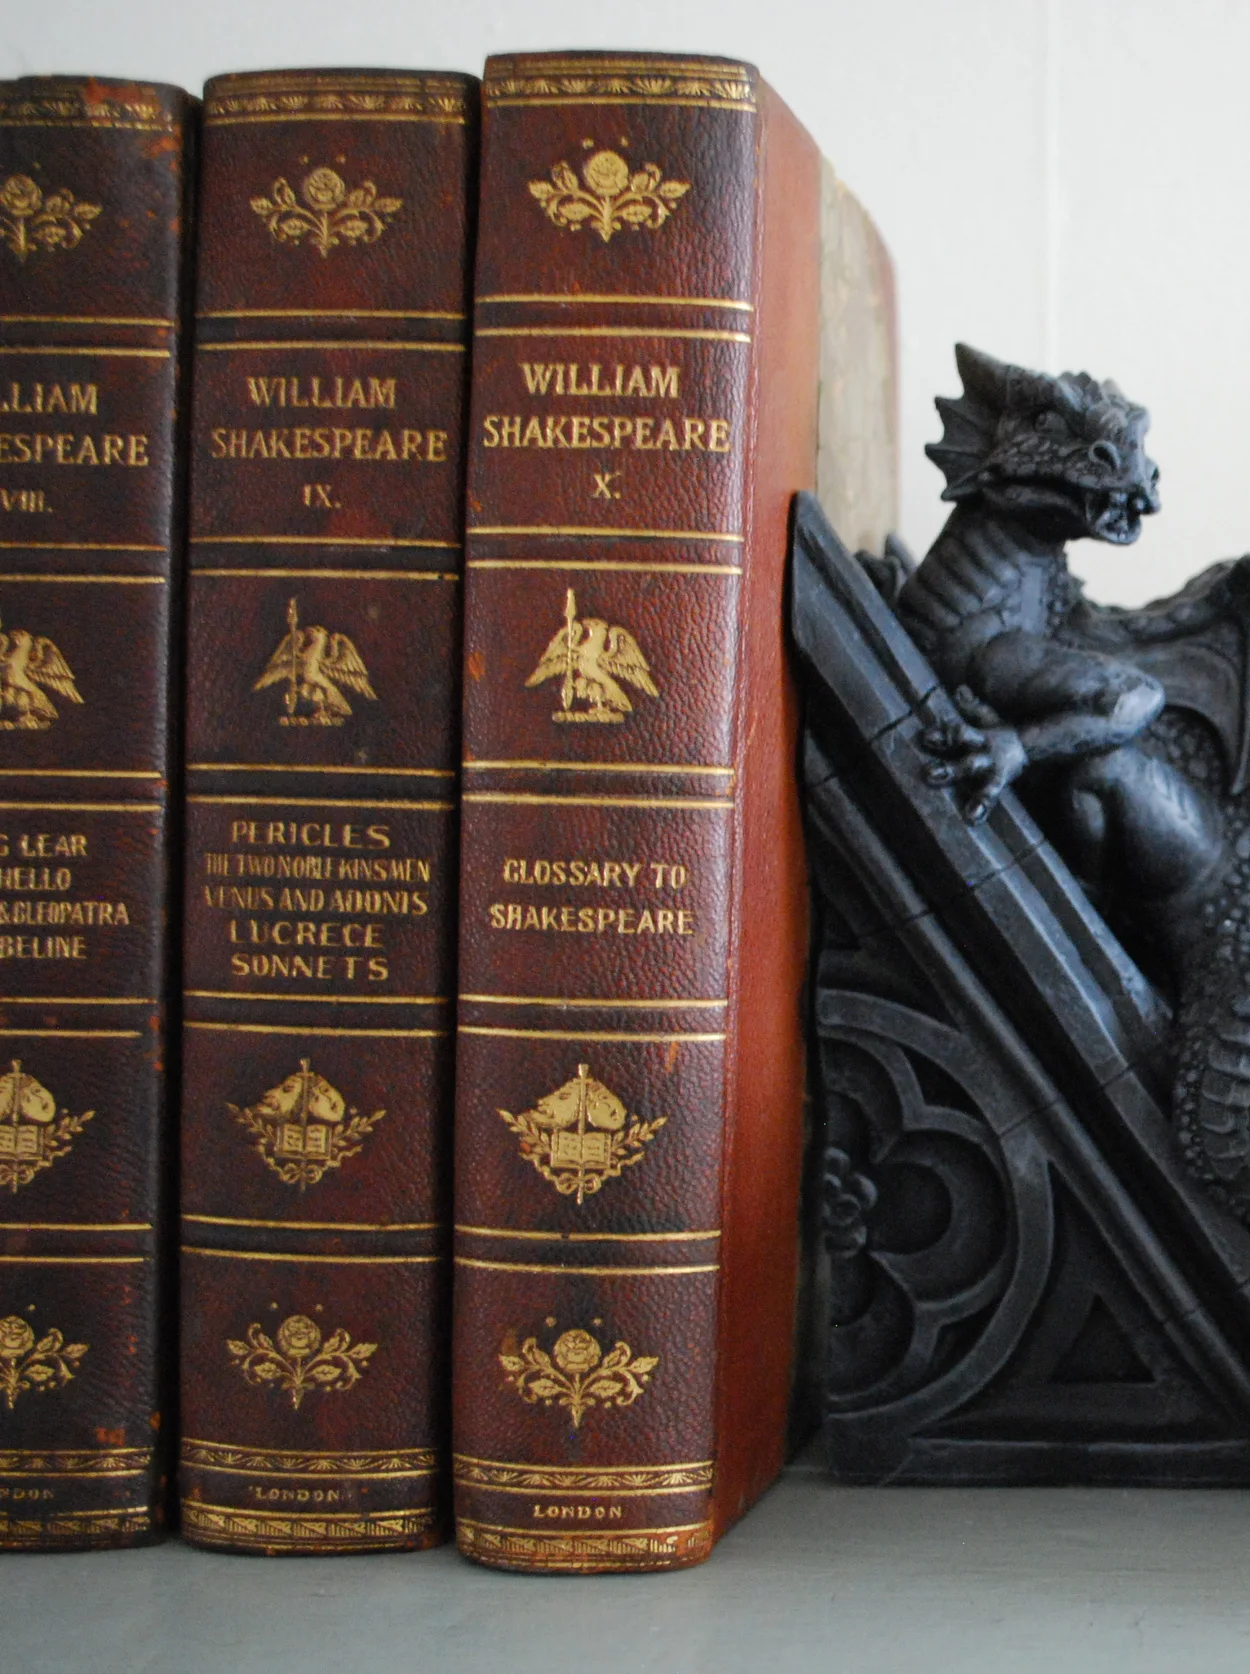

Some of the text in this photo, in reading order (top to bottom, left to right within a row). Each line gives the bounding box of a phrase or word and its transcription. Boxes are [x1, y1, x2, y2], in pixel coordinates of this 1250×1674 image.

[247, 376, 397, 408] WILLIAM
[520, 362, 681, 398] WILLIAM
[211, 427, 448, 462] SHAKESPEARE
[483, 415, 731, 452] SHAKESPEARE
[303, 484, 342, 508] IX.
[20, 834, 88, 857] LEAR
[231, 820, 391, 849] PERICLES
[205, 853, 431, 882] THE TWO NOBLE KINSMEN
[503, 859, 687, 889] GLOSSARY TO
[204, 885, 428, 916] VENUS AND ADONIS
[230, 919, 386, 948] LUCRECE
[490, 904, 694, 935] SHAKESPEARE
[255, 1487, 340, 1501] LONDON
[533, 1504, 622, 1519] LONDON
